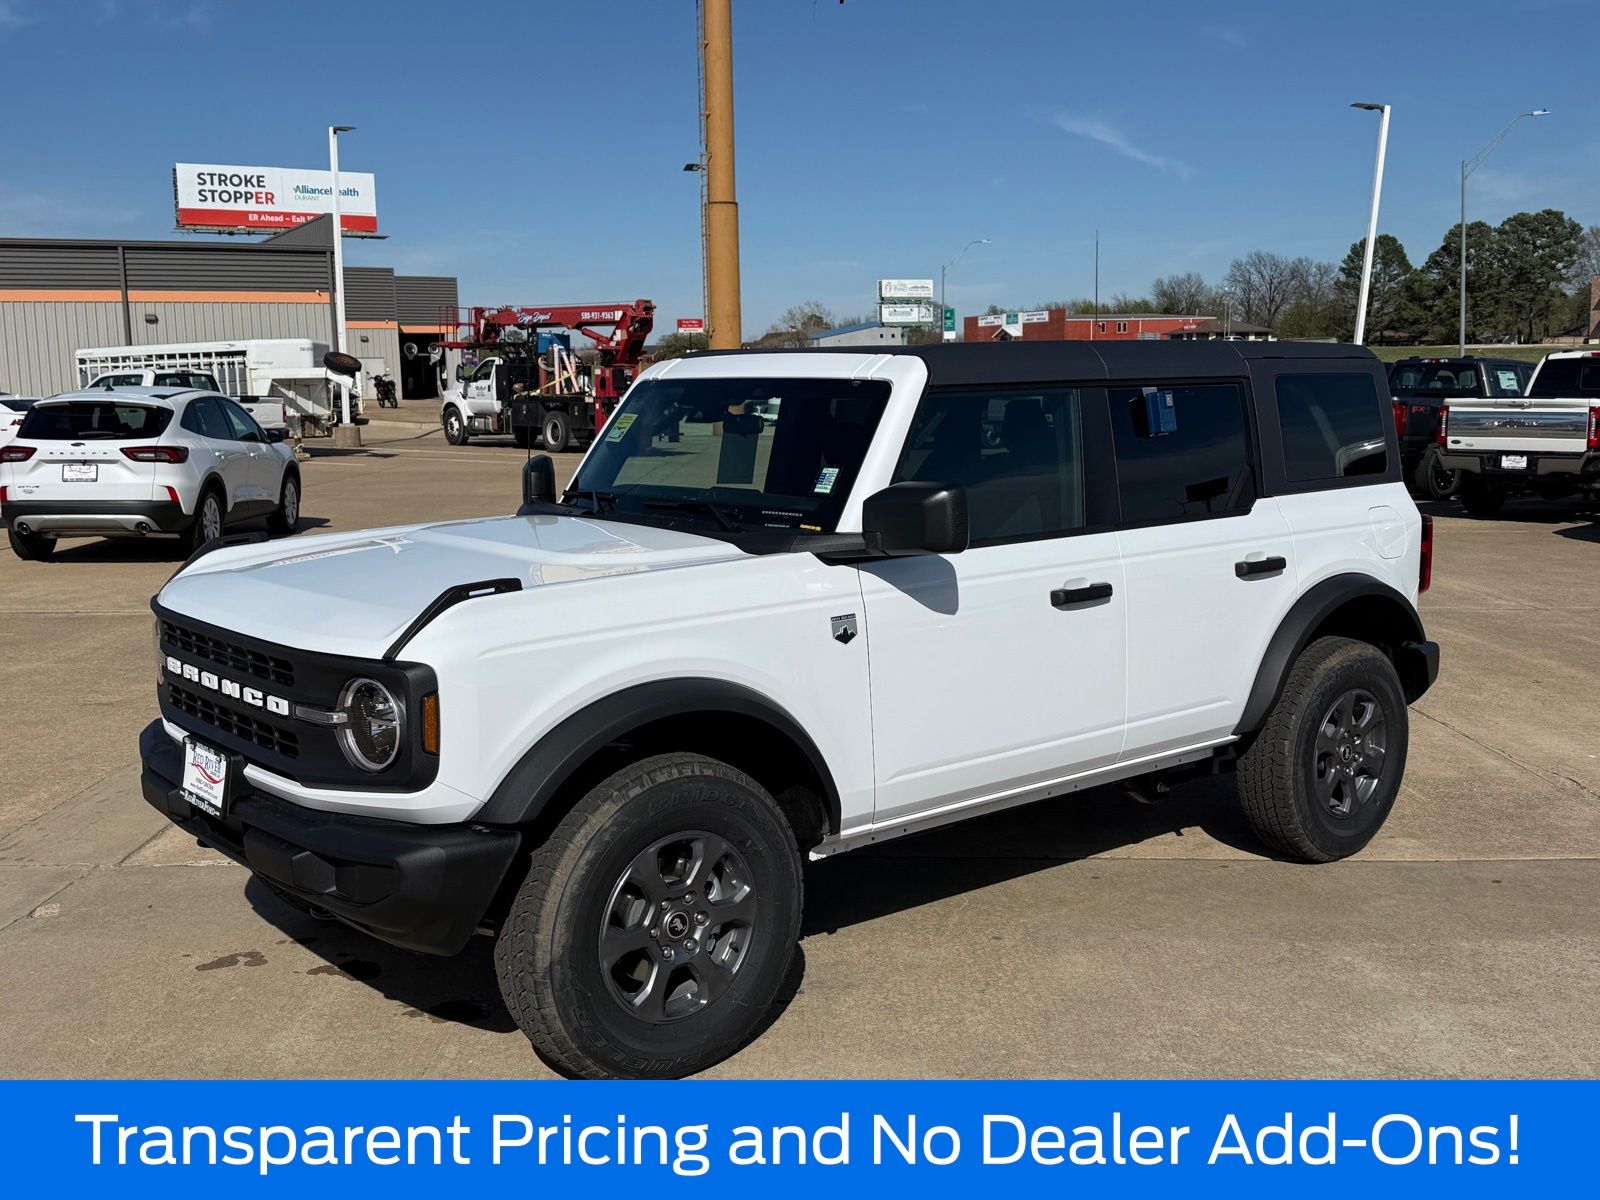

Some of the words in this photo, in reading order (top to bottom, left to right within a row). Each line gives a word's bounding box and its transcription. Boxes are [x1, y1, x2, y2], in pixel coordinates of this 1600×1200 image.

[197, 172, 266, 188] STROKE
[198, 189, 275, 205] STOPPER
[294, 185, 359, 197] Allianceealth
[248, 213, 259, 221] ER
[260, 214, 284, 222] Ahead
[291, 215, 305, 223] Exit
[581, 311, 614, 320] 580-931-9363
[167, 656, 289, 716] BRONCO
[193, 751, 204, 765] RED
[205, 755, 222, 774] RIVER
